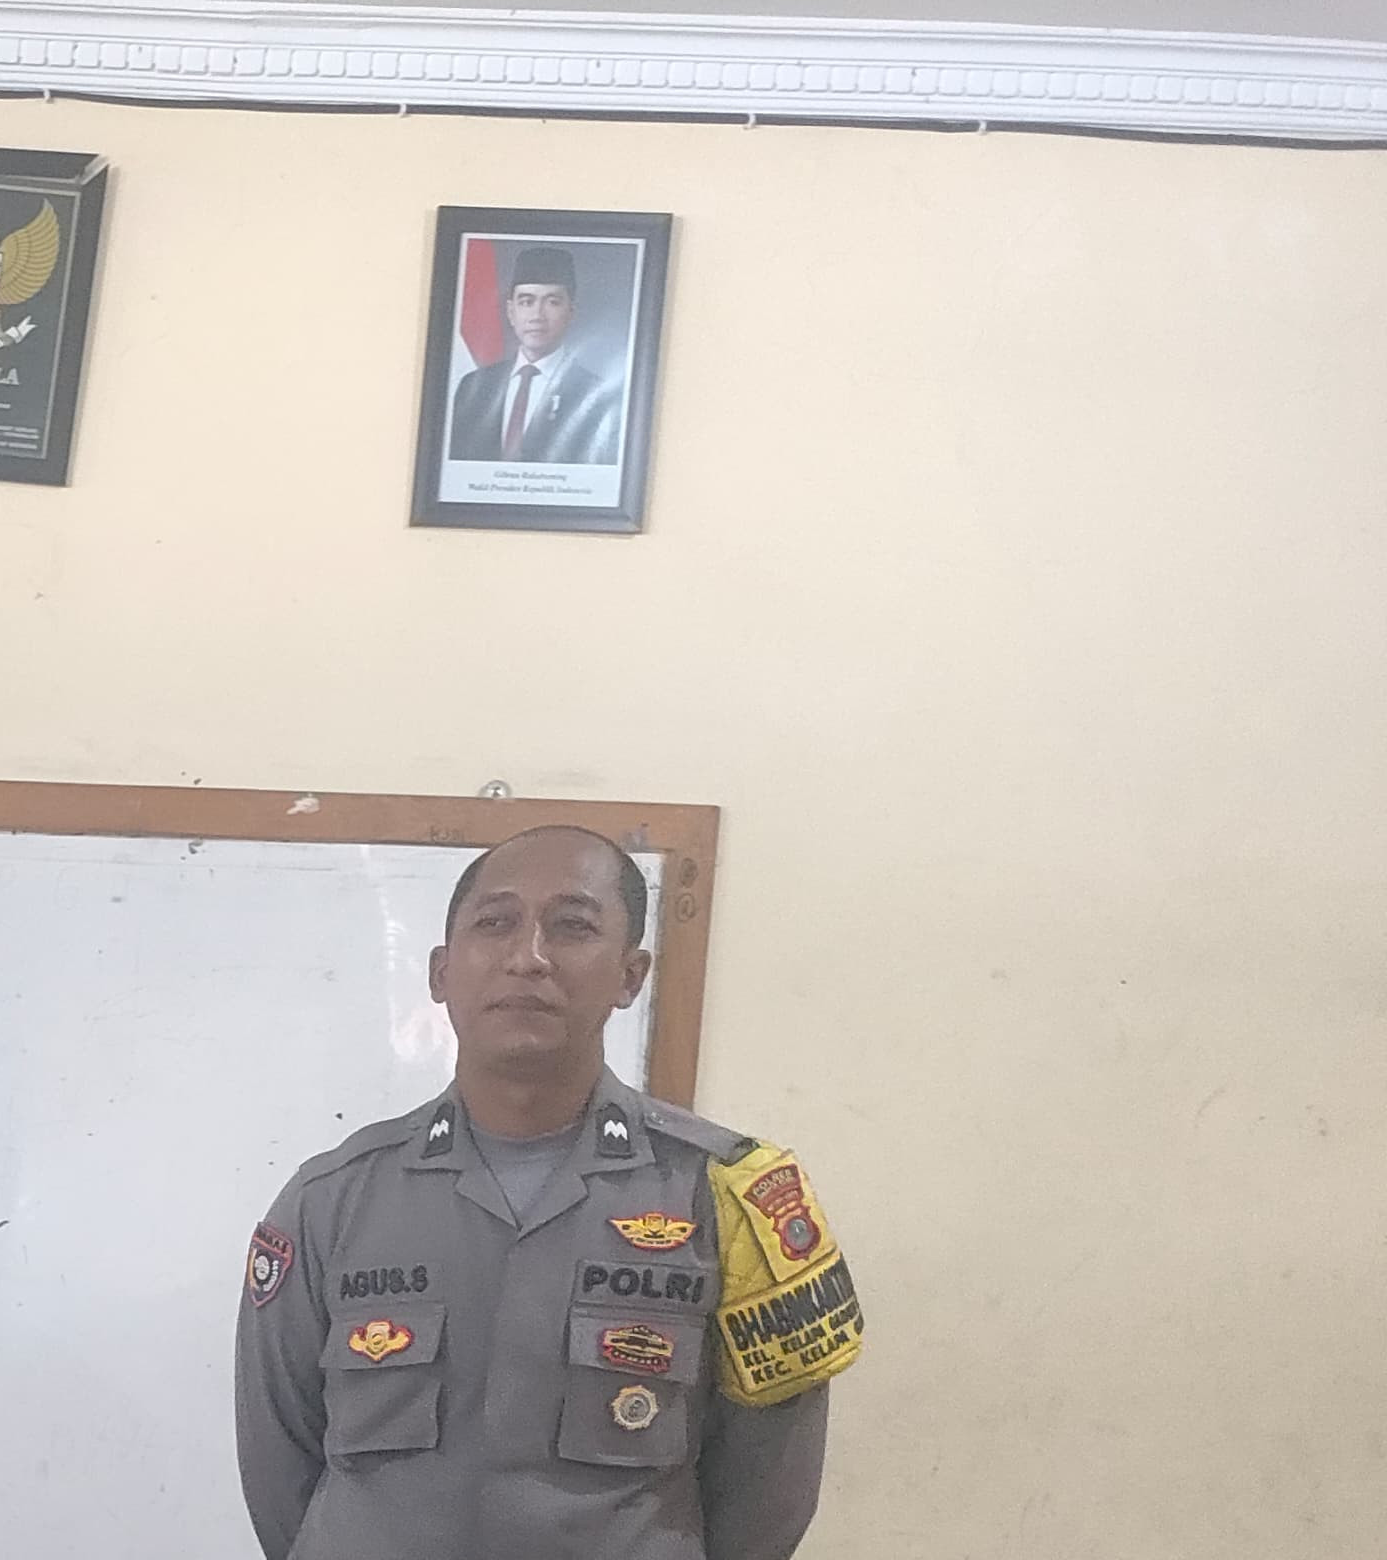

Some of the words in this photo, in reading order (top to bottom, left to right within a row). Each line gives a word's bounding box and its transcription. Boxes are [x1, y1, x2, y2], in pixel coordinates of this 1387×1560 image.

[339, 1264, 429, 1301] AGUS.S
[582, 1264, 705, 1304] POLRI
[750, 1360, 793, 1385] KEC.
